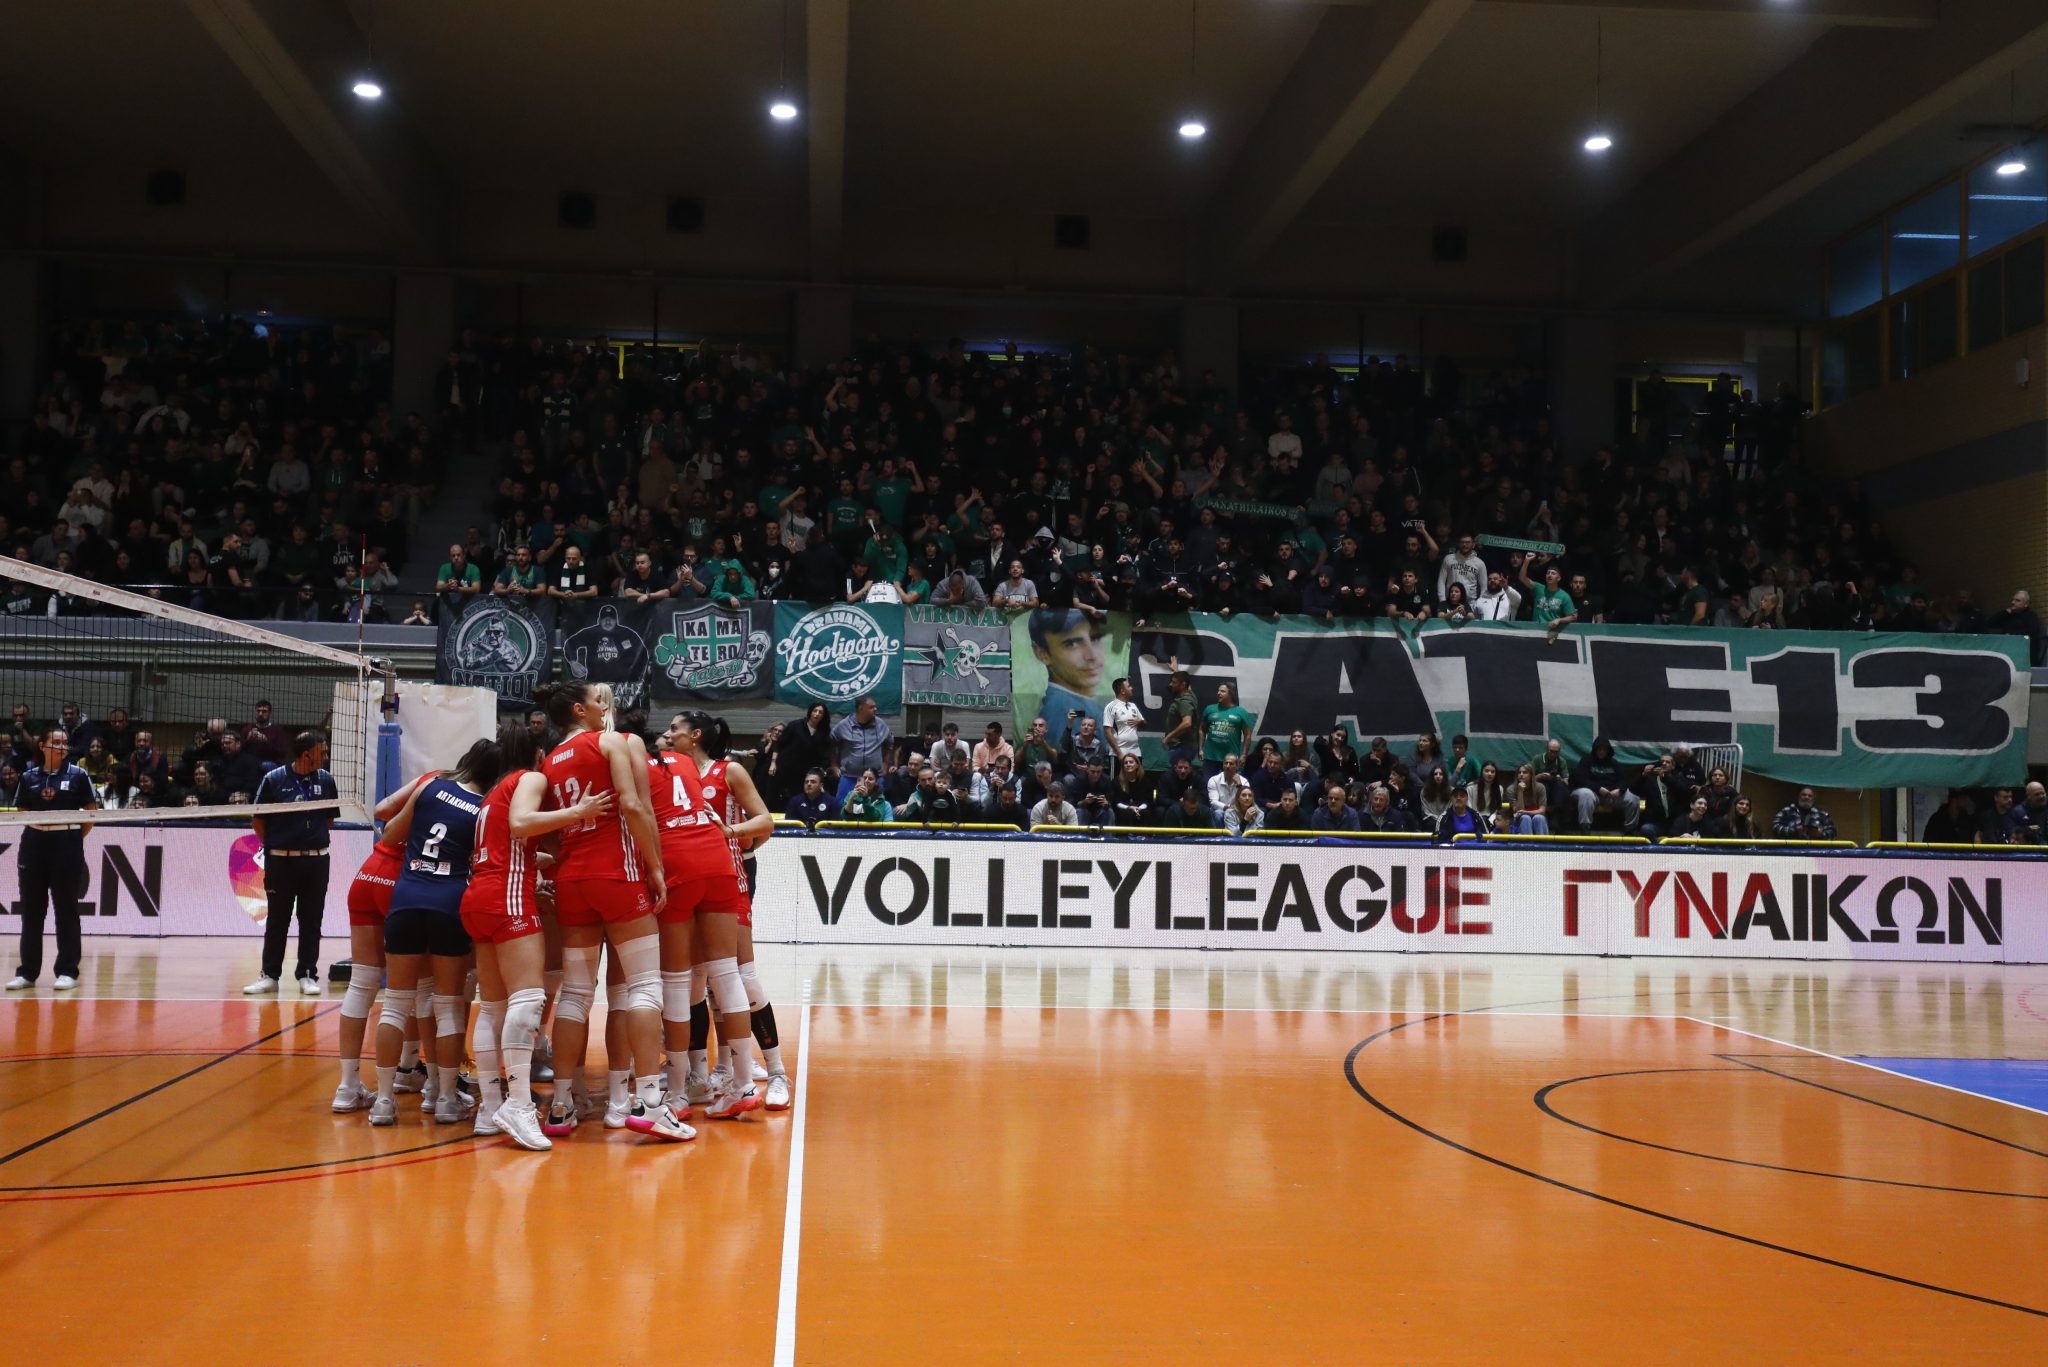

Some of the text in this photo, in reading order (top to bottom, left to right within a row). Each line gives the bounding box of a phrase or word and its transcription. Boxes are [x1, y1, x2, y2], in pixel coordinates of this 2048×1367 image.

[685, 619, 741, 637] KA MA
[803, 611, 872, 635] BRAHAMI
[691, 646, 709, 660] TE
[777, 630, 900, 676] Hooligans
[908, 690, 1009, 707] NEVER GIVE UP
[436, 790, 480, 815] ARTAKIANOU
[672, 775, 692, 811] 4
[422, 822, 447, 859] 2
[801, 855, 1492, 935] VOLLEYLEAGUE
[1563, 869, 2003, 945] ΓΥΝΑΙΚΩΝ
